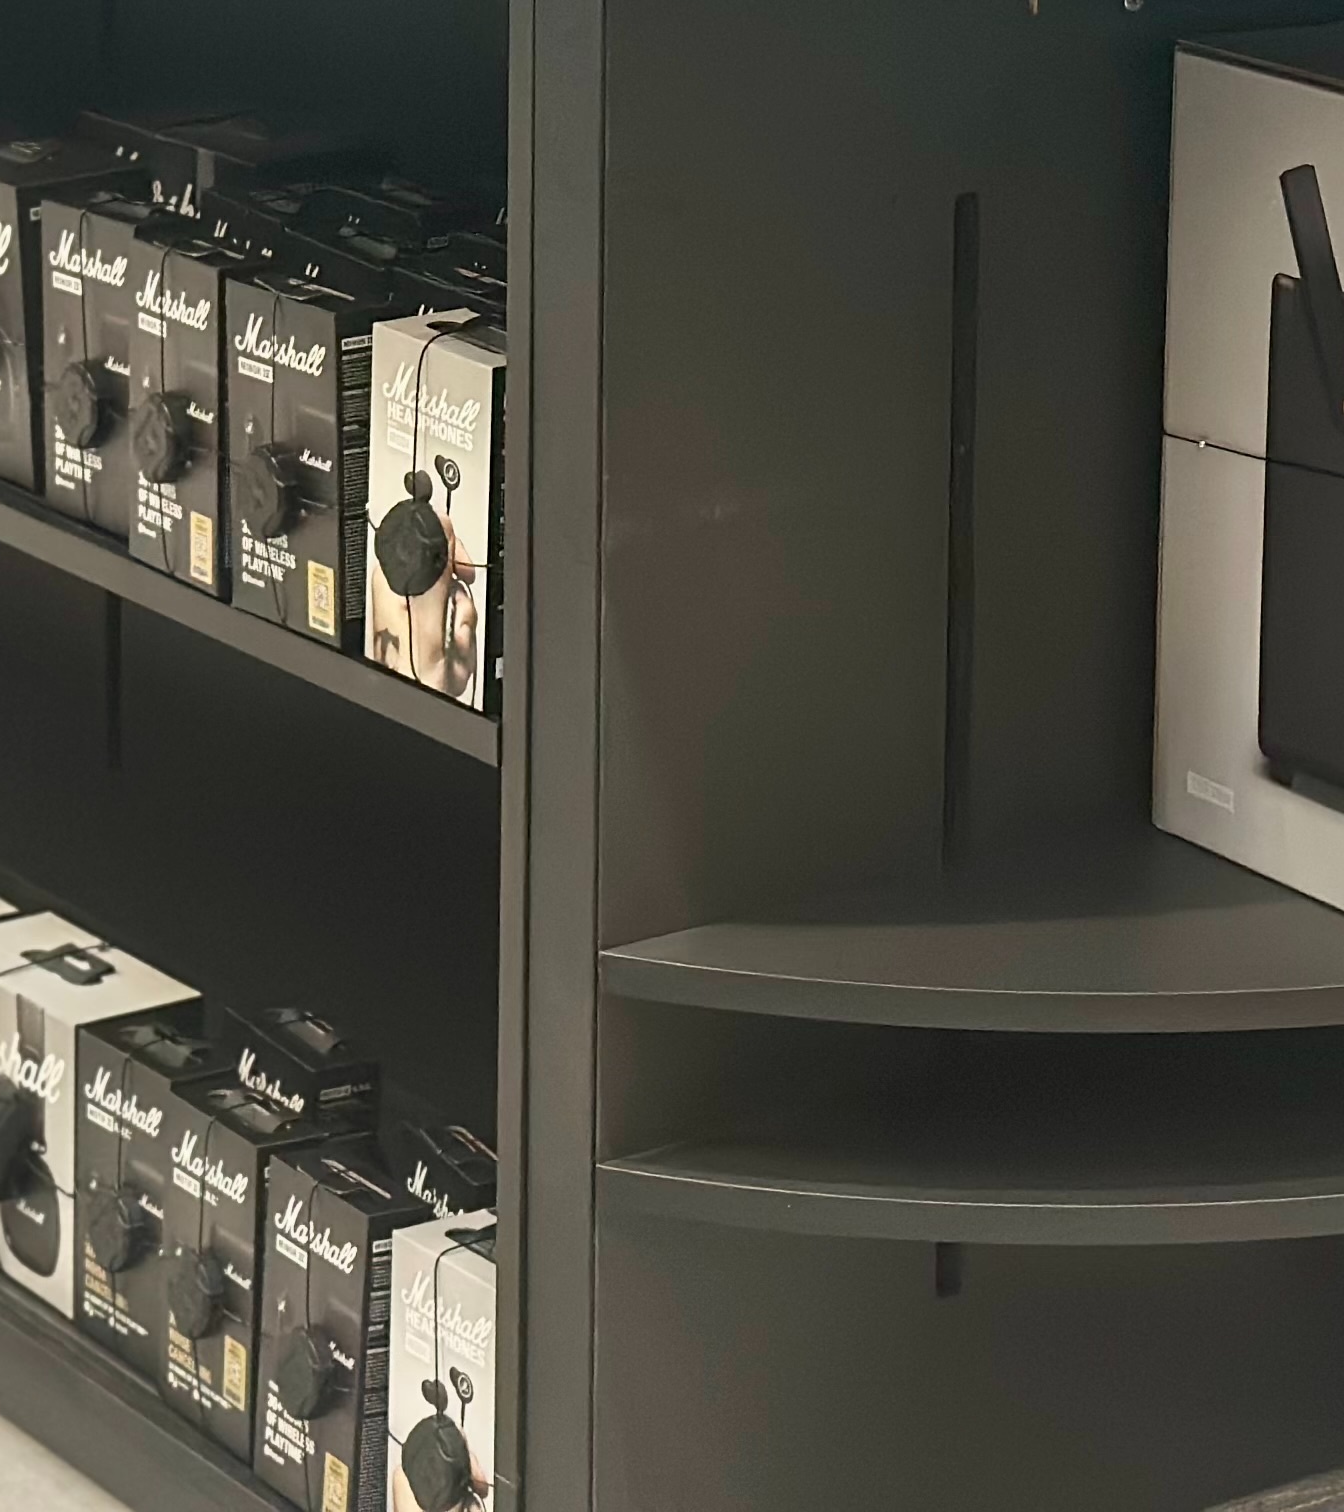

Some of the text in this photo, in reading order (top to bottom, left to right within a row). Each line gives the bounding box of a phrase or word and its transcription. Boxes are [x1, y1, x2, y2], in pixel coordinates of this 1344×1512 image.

[49, 229, 128, 288] Marshall
[235, 312, 327, 377] Marshall
[138, 504, 174, 533] PLAYTIE
[85, 1065, 163, 1137] Marshall
[171, 1129, 249, 1204] Marshall
